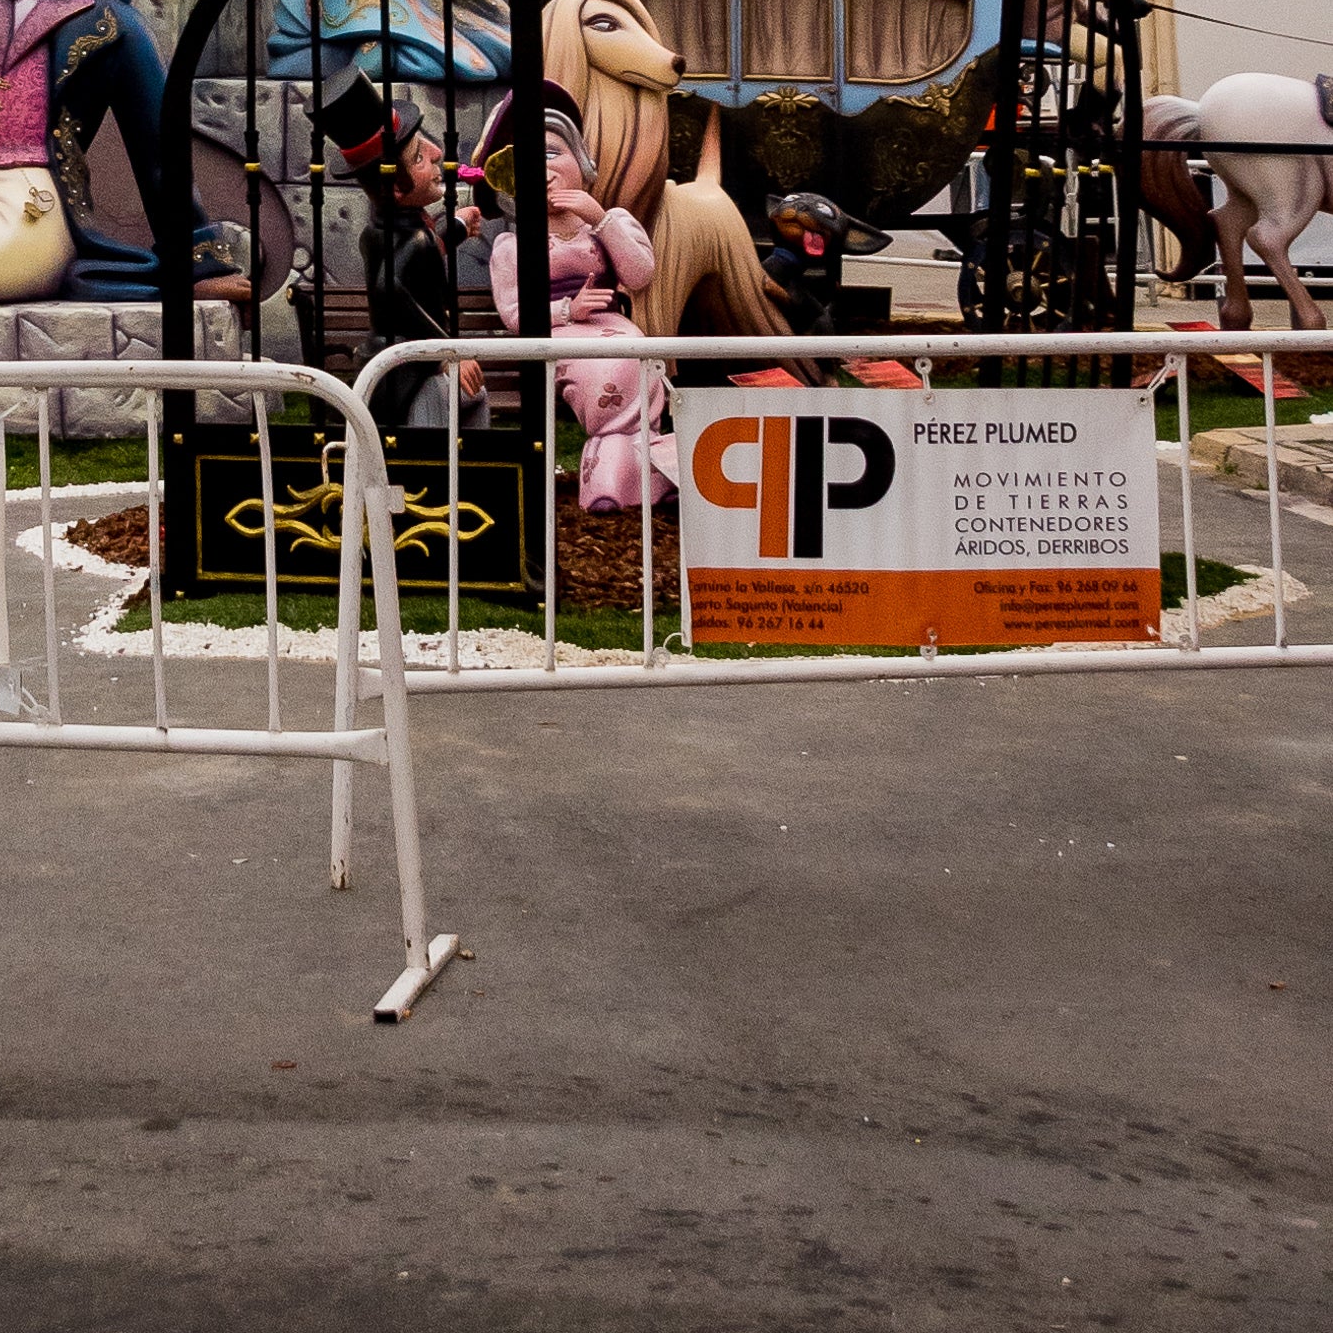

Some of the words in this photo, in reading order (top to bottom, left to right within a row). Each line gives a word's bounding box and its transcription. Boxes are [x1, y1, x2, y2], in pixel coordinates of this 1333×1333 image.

[913, 417, 978, 444] PÉREZ
[985, 422, 1078, 444] PLUMED
[954, 471, 1127, 488] MOVIMIENTO
[954, 495, 986, 511] DE
[1008, 494, 1128, 510] TIERRAS
[954, 516, 1129, 533] CONTENEDORES
[954, 536, 1031, 557] ÁRIDOS,
[1037, 538, 1130, 555] DERRIBOS
[735, 580, 747, 593] la
[803, 581, 823, 596] s/n
[827, 581, 870, 594] 46520
[973, 580, 1016, 594] Oficina
[1019, 584, 1027, 597] y
[692, 599, 722, 611] uerto
[726, 597, 778, 613] Sagunto
[782, 598, 843, 615] (Valencia)
[737, 616, 754, 630] 96
[757, 616, 783, 630] 267
[789, 616, 804, 631] 16
[808, 617, 824, 631] 44
